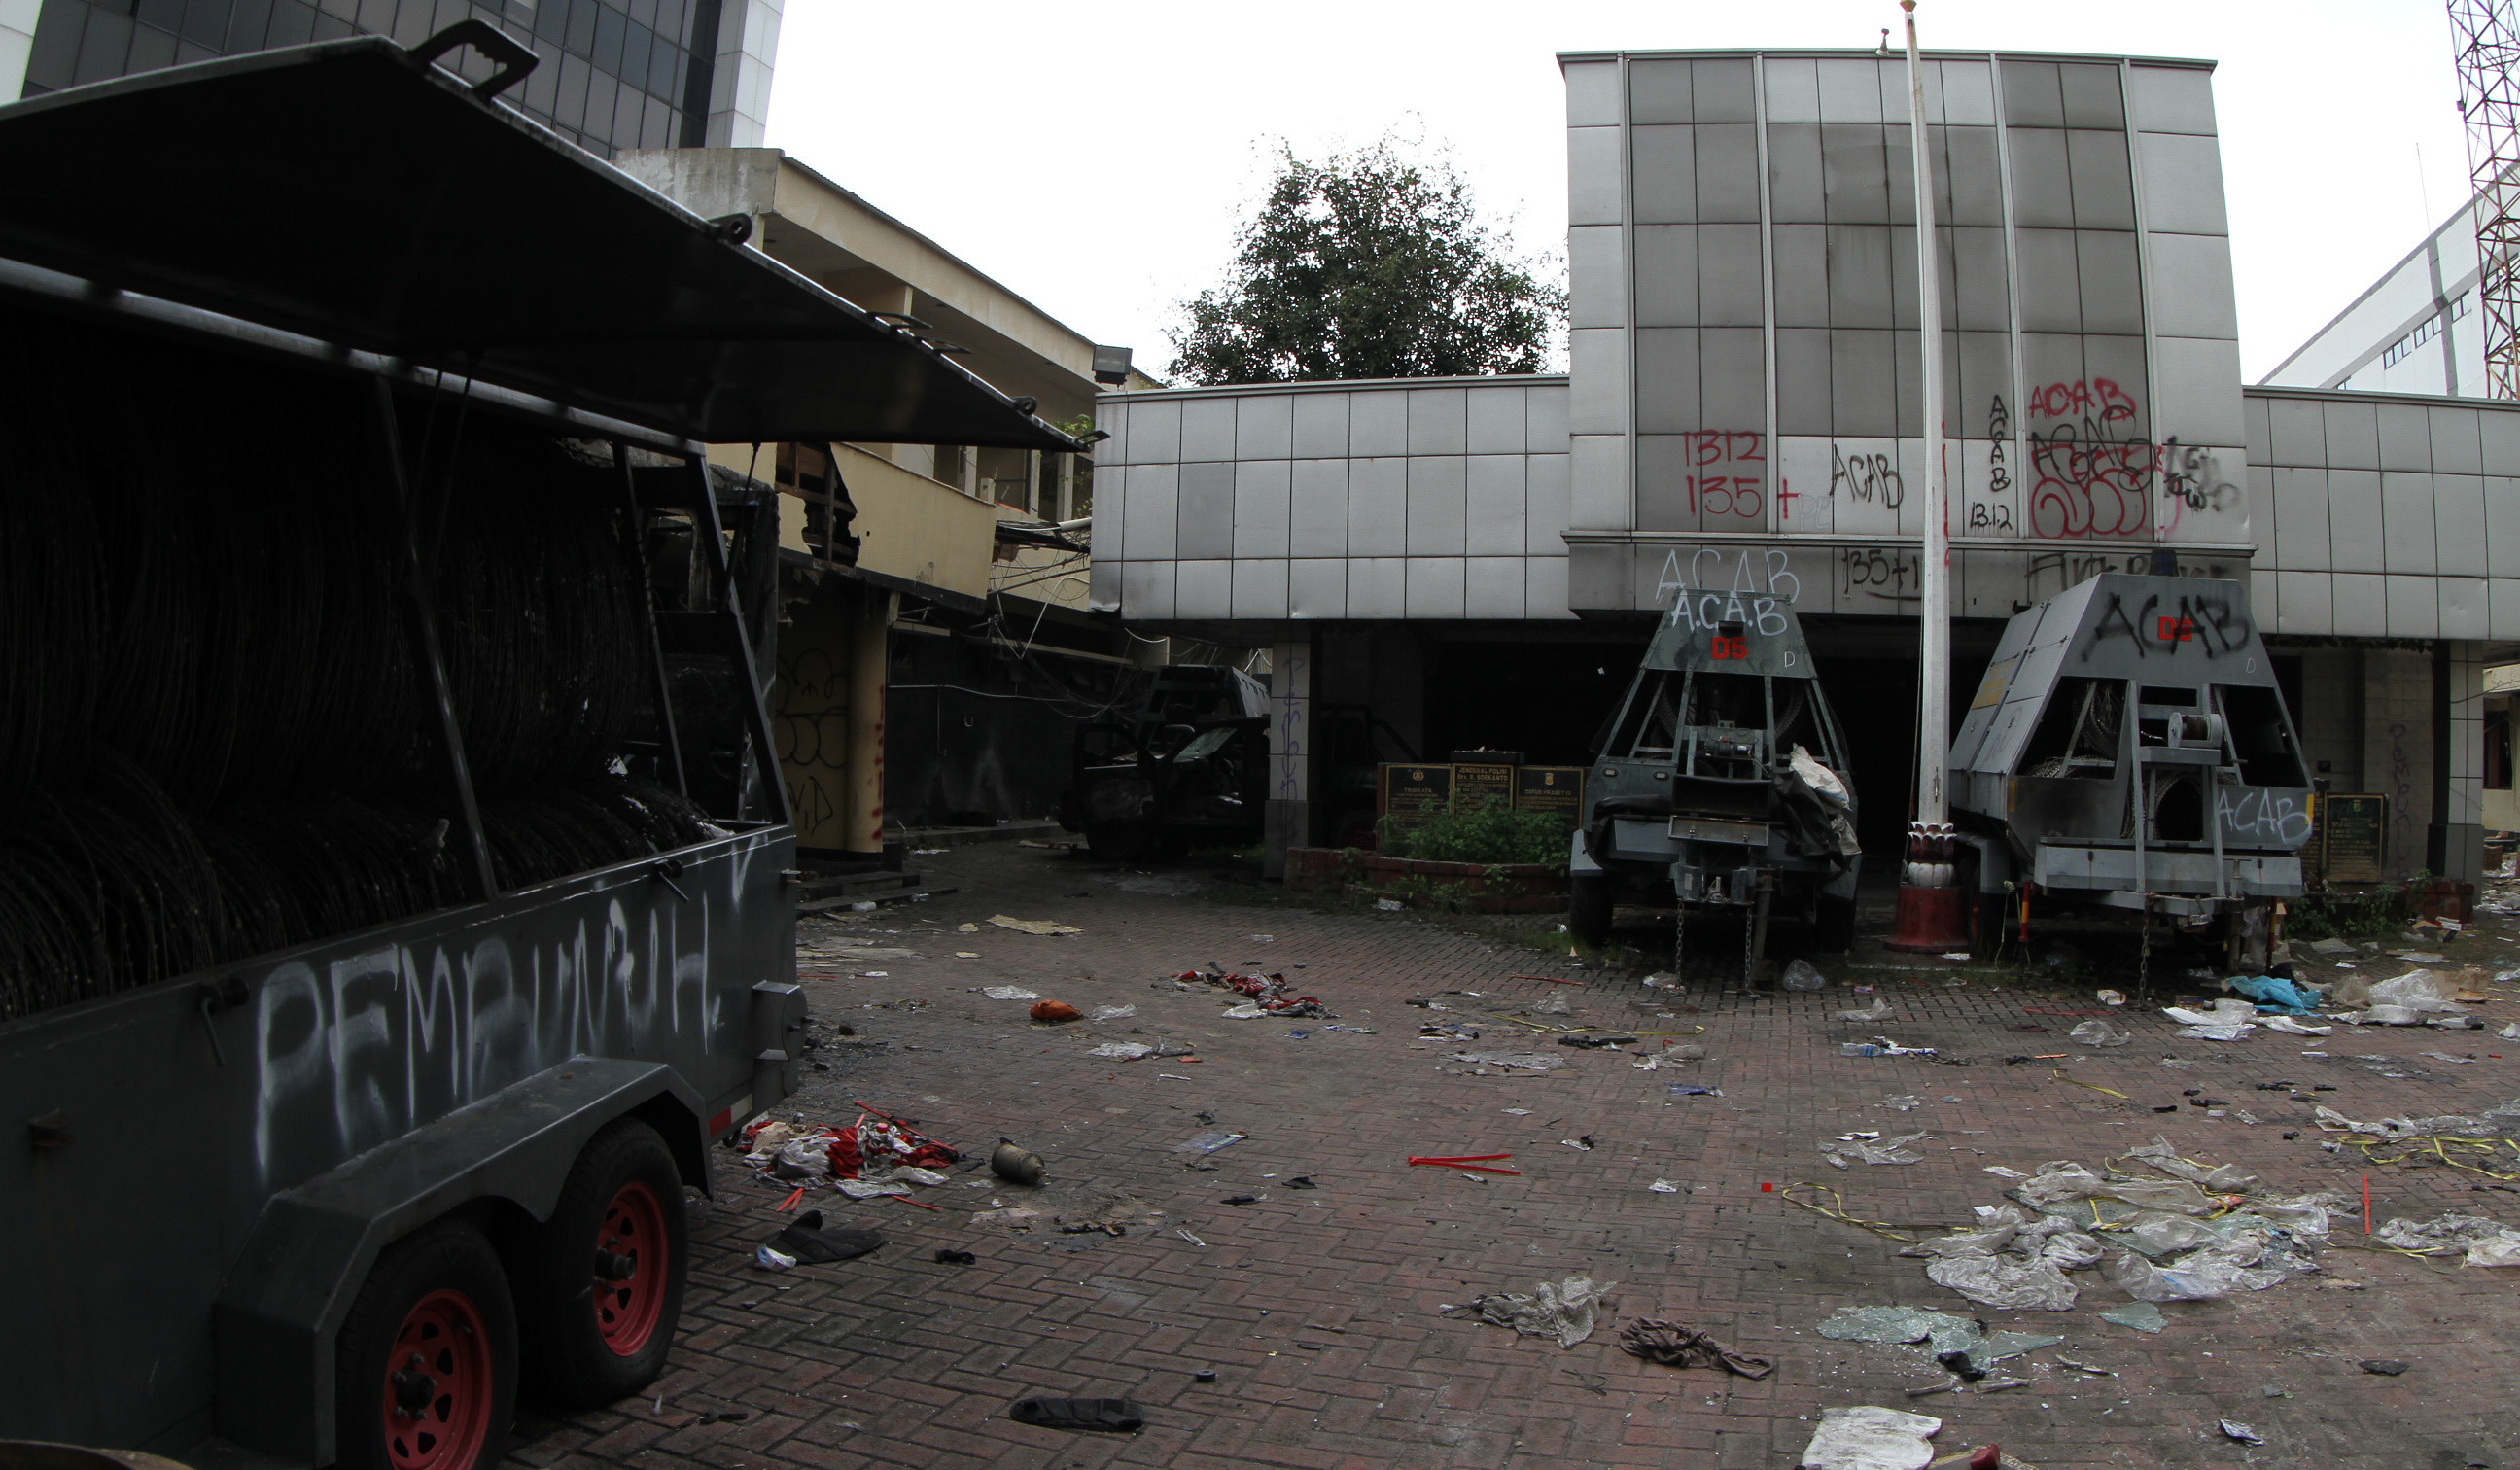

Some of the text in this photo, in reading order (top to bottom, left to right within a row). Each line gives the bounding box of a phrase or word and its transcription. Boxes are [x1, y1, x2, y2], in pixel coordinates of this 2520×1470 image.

[2029, 376, 2137, 421] ACAB
[1682, 429, 1767, 467] 1312
[1829, 443, 1904, 509] ACAB
[1711, 636, 1748, 660] D5
[2081, 592, 2251, 662] ACAB
[1784, 651, 1796, 668] D
[2217, 788, 2314, 845] ACAB
